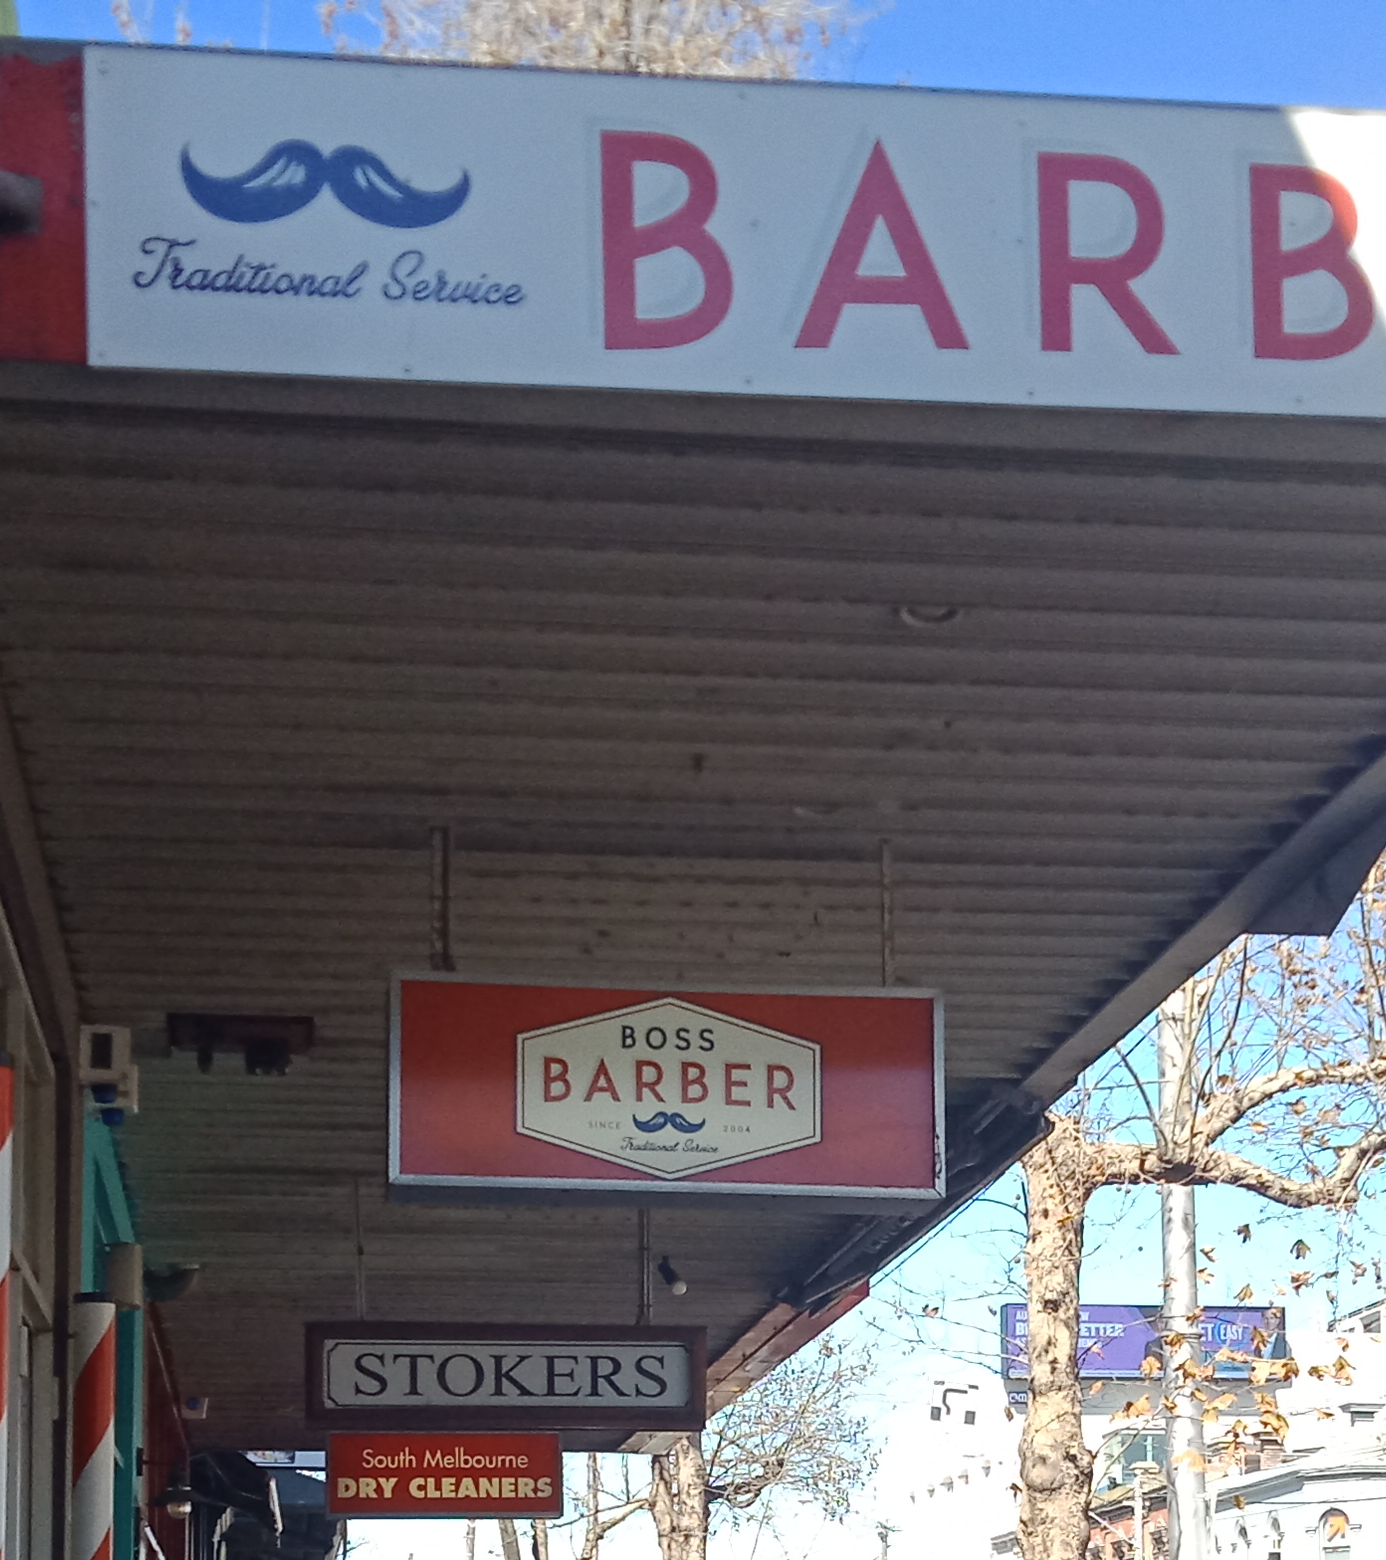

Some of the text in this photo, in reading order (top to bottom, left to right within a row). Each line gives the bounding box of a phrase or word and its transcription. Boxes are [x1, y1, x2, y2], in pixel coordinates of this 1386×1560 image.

[133, 235, 525, 305] Traditional Service
[620, 1025, 716, 1053] BOSS
[542, 1056, 798, 1112] BARBER
[587, 1120, 751, 1133] SINCE 2004
[353, 1352, 668, 1398] STOKERS
[361, 1446, 529, 1470] South Melbourne
[337, 1477, 553, 1499] DRY CLEANERS
